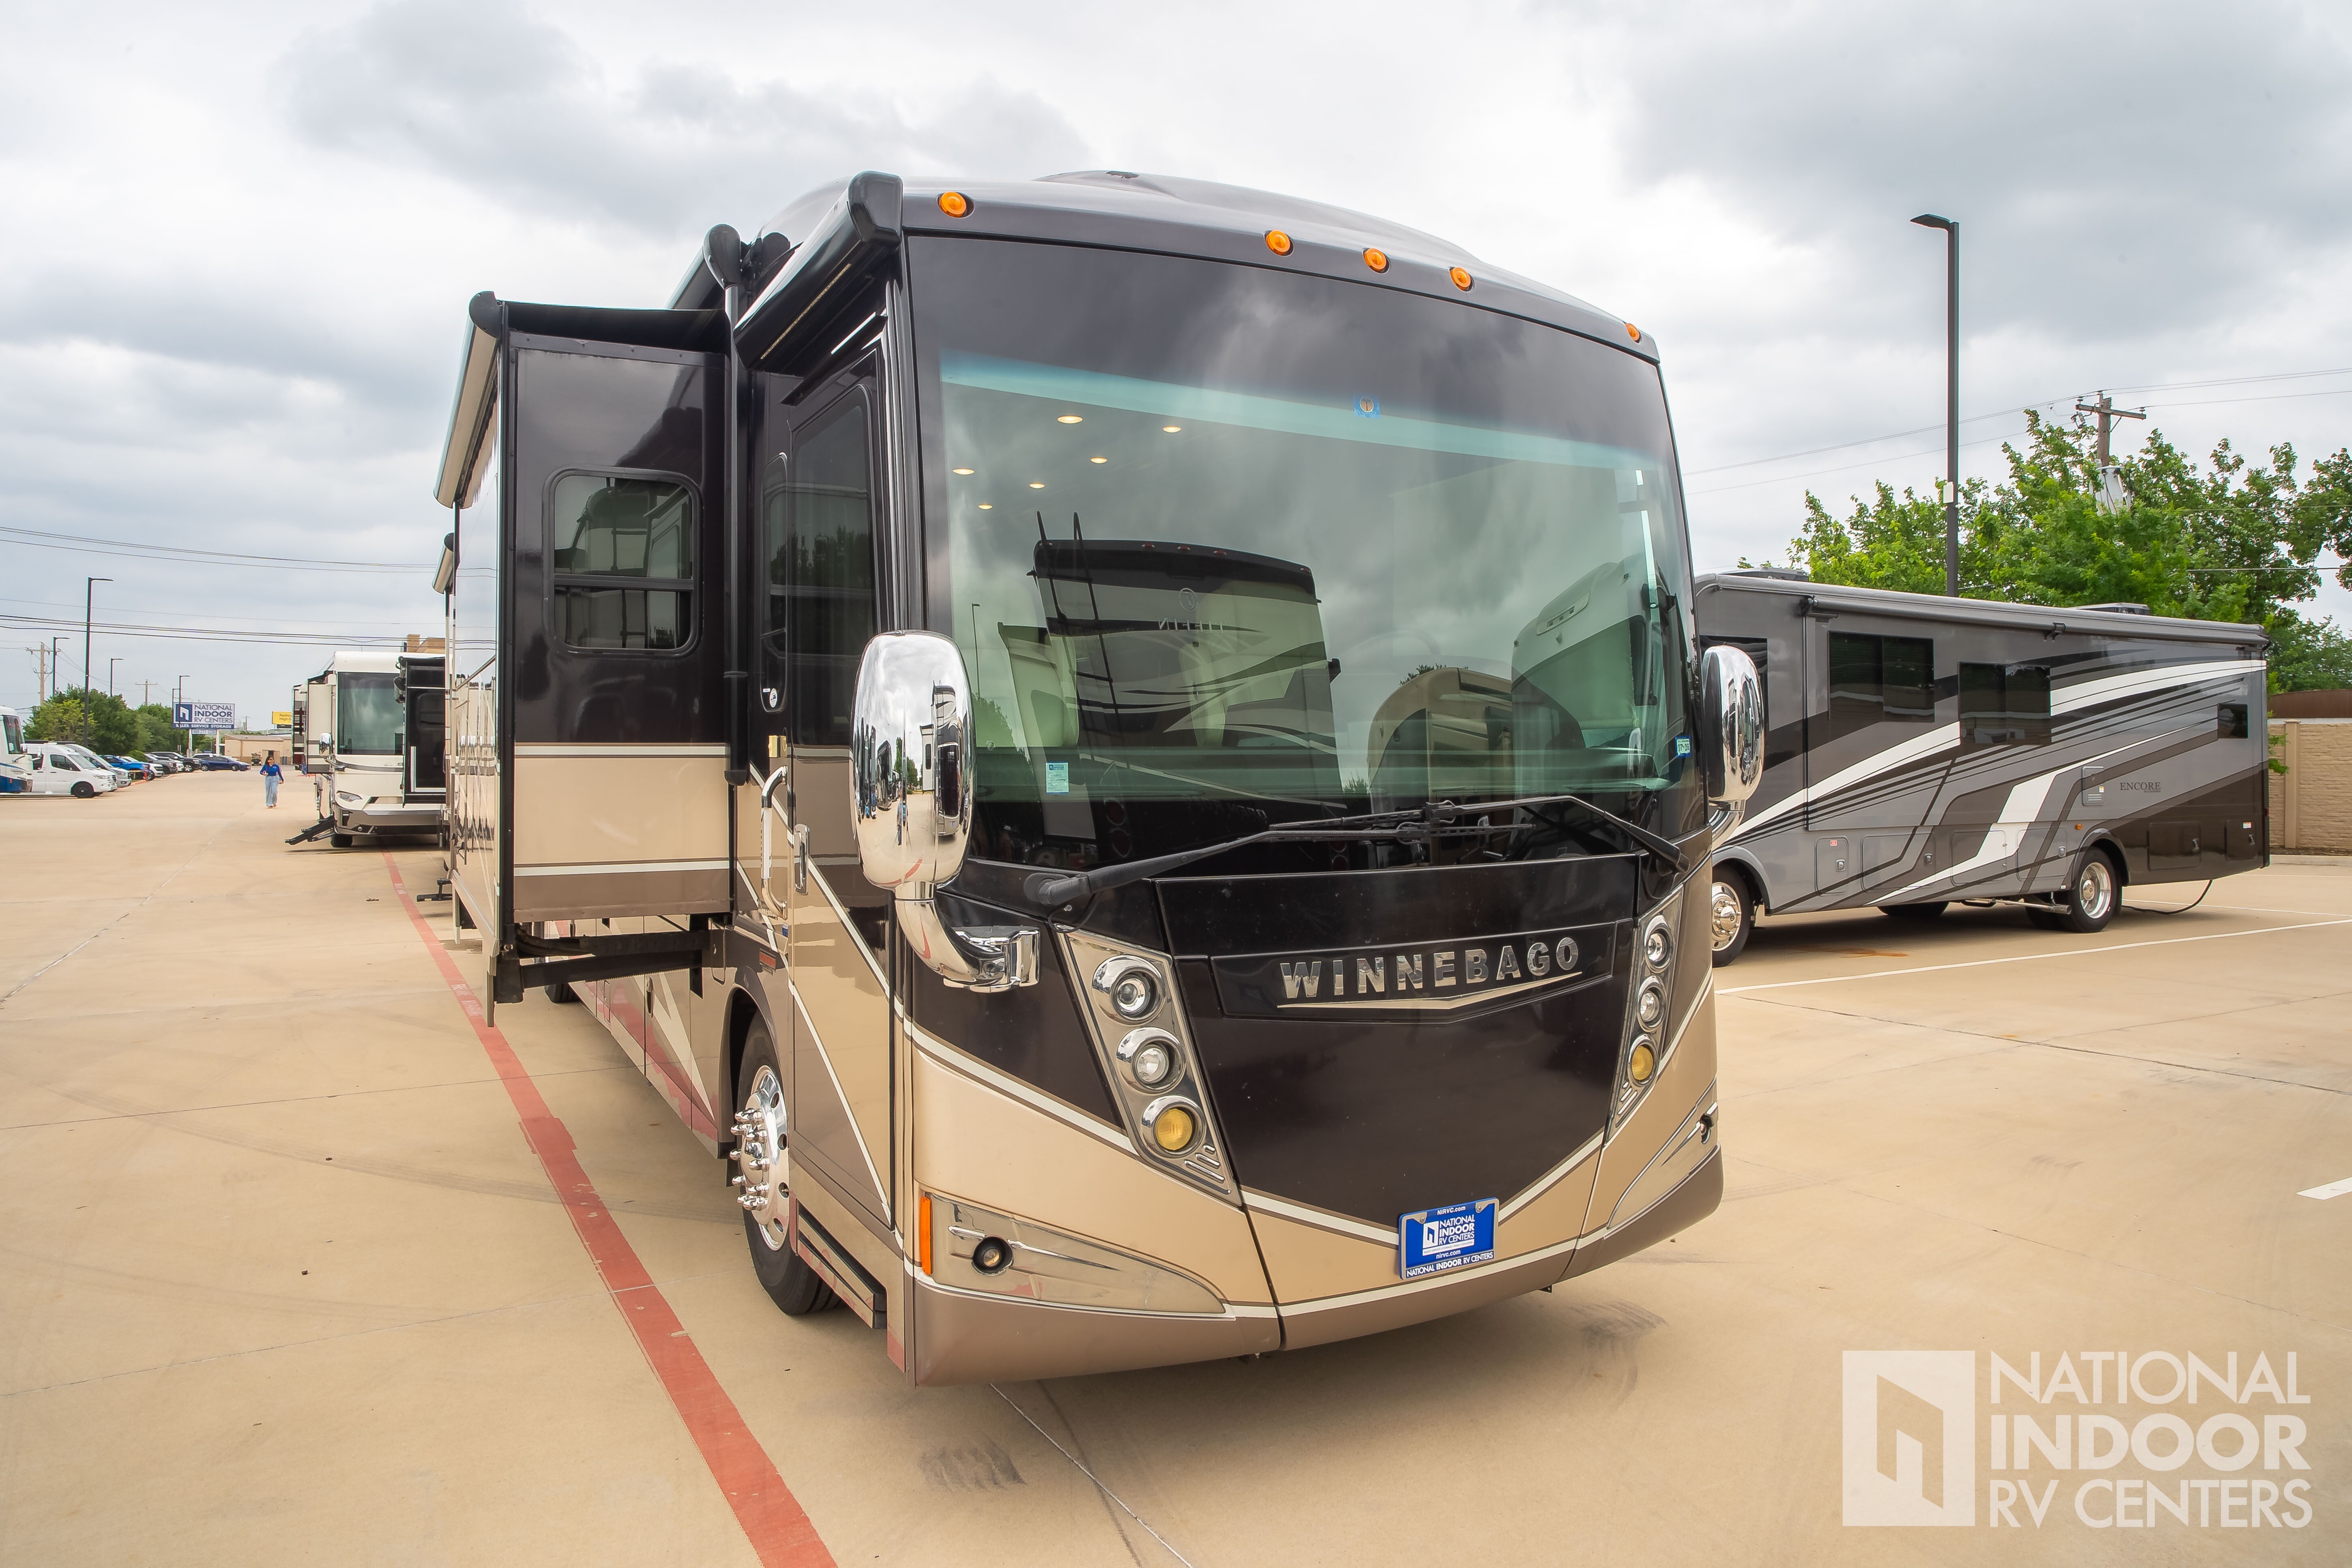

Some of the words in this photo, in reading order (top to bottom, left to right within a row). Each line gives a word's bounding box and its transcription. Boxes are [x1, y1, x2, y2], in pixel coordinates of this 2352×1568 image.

[2120, 782, 2161, 790] ENCORE
[1280, 937, 1577, 999] WINNEBAGO
[1437, 1206, 1466, 1215] NIRVC.com
[1440, 1214, 1475, 1228] NATIONAL
[1439, 1223, 1474, 1237] INDOOR
[1439, 1237, 1447, 1245] RV
[1448, 1231, 1474, 1243] CENTERS
[1436, 1250, 1461, 1259] nirvc.com
[1407, 1265, 1434, 1277] NATIONAL
[1436, 1259, 1461, 1270] INDOOR
[1471, 1252, 1493, 1262] CENTERS
